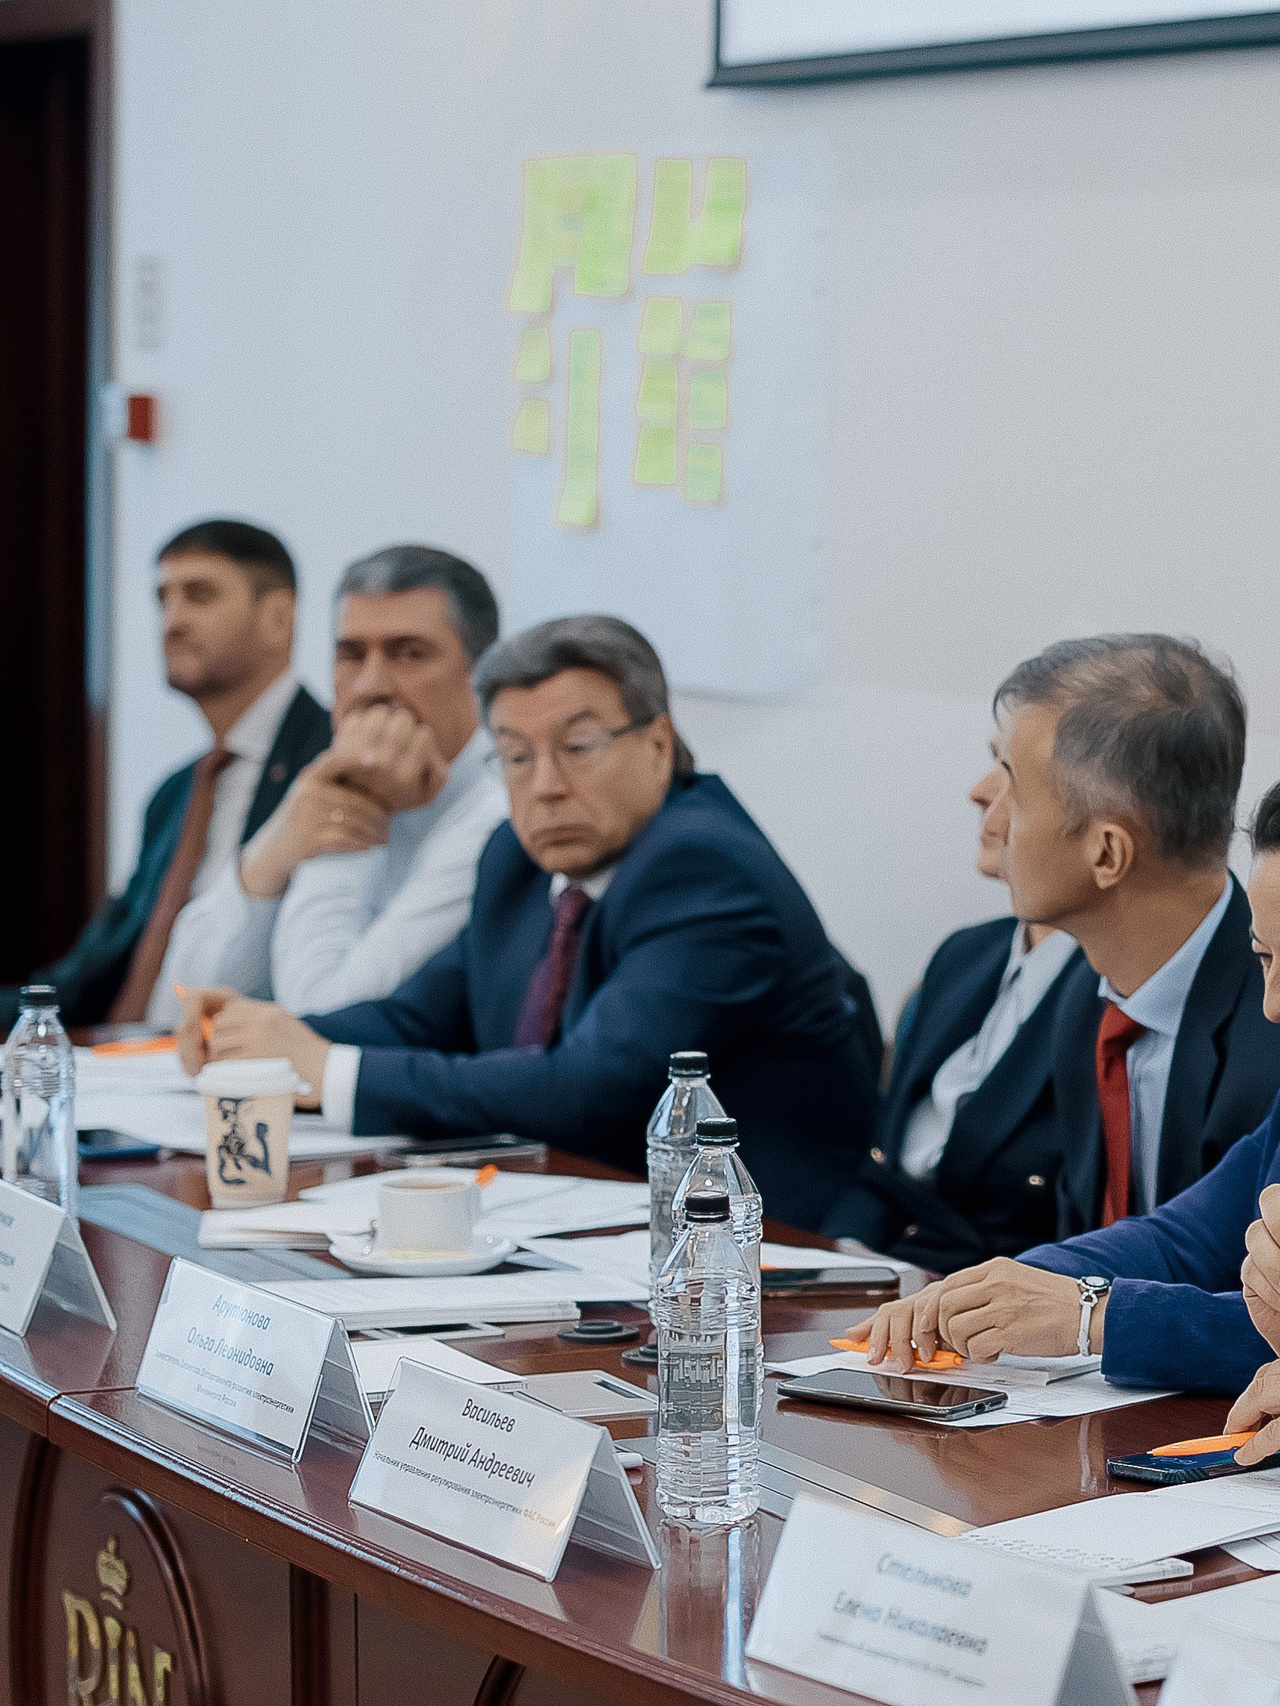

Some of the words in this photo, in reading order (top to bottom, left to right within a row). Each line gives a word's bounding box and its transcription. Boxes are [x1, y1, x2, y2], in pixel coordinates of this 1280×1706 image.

[212, 1294, 271, 1331] Арутюнова
[187, 1326, 215, 1351] Ольга
[214, 1338, 275, 1376] Леонидовна
[461, 1398, 516, 1433] Васильев
[409, 1426, 472, 1463] Дмитрий
[467, 1448, 536, 1488] Андреевич
